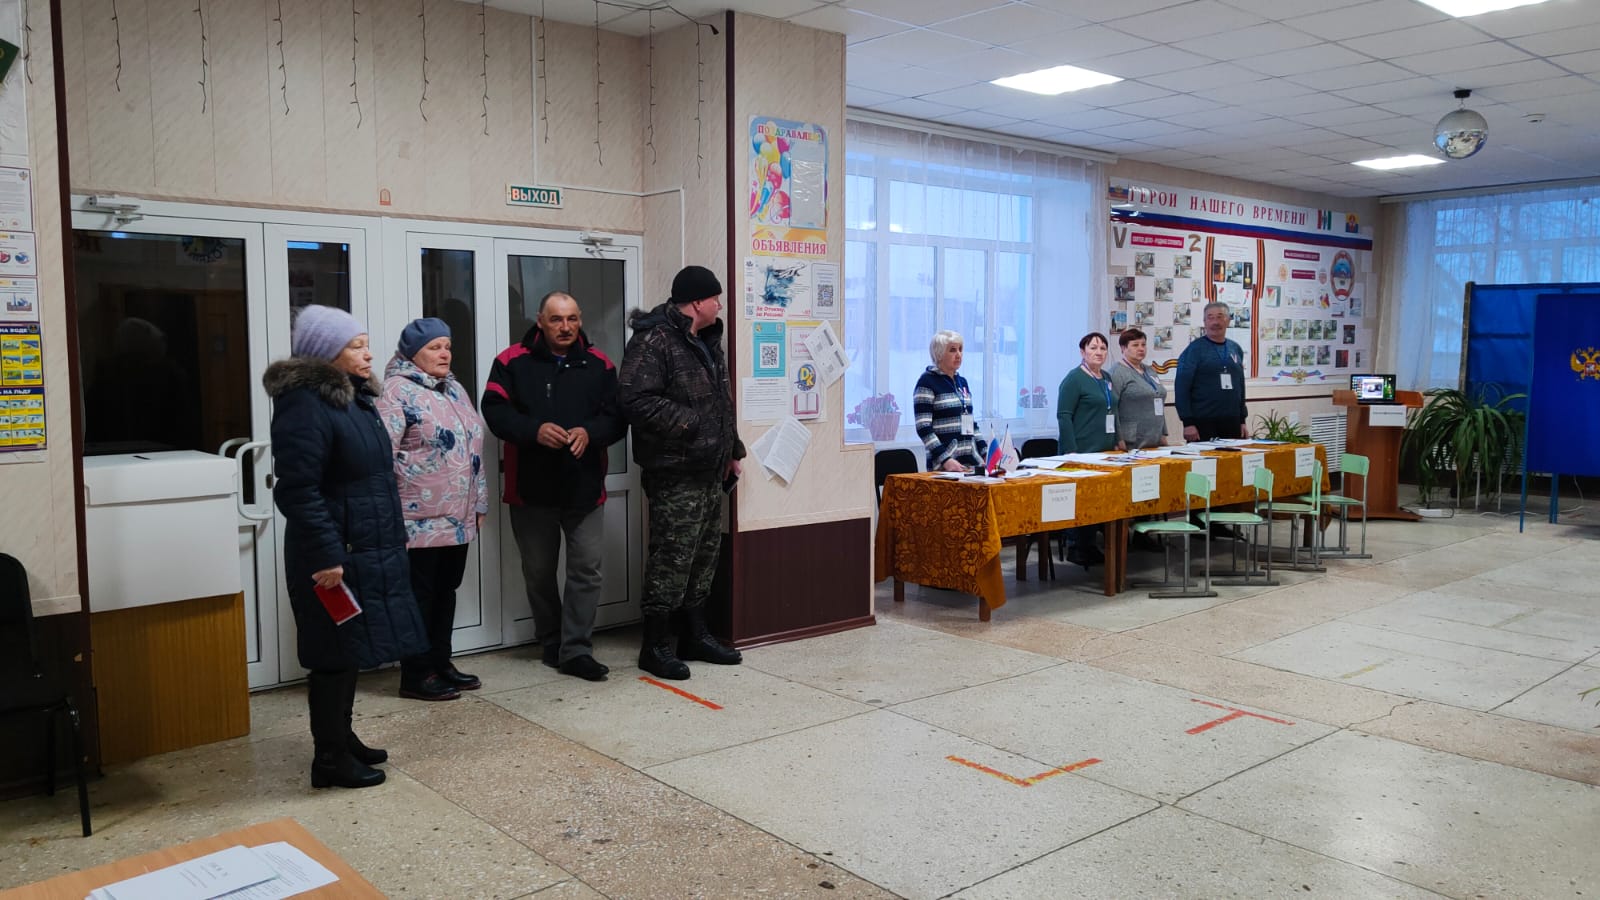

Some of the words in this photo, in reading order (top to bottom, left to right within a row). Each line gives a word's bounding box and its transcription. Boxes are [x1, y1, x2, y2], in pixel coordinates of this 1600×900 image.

[511, 188, 558, 205] ВЫХОД
[1190, 196, 1244, 216] НАШЕГО
[1253, 205, 1306, 225] ВРЕМЕНИ
[752, 238, 826, 255] ОБЪЯВЛЕНИЯ
